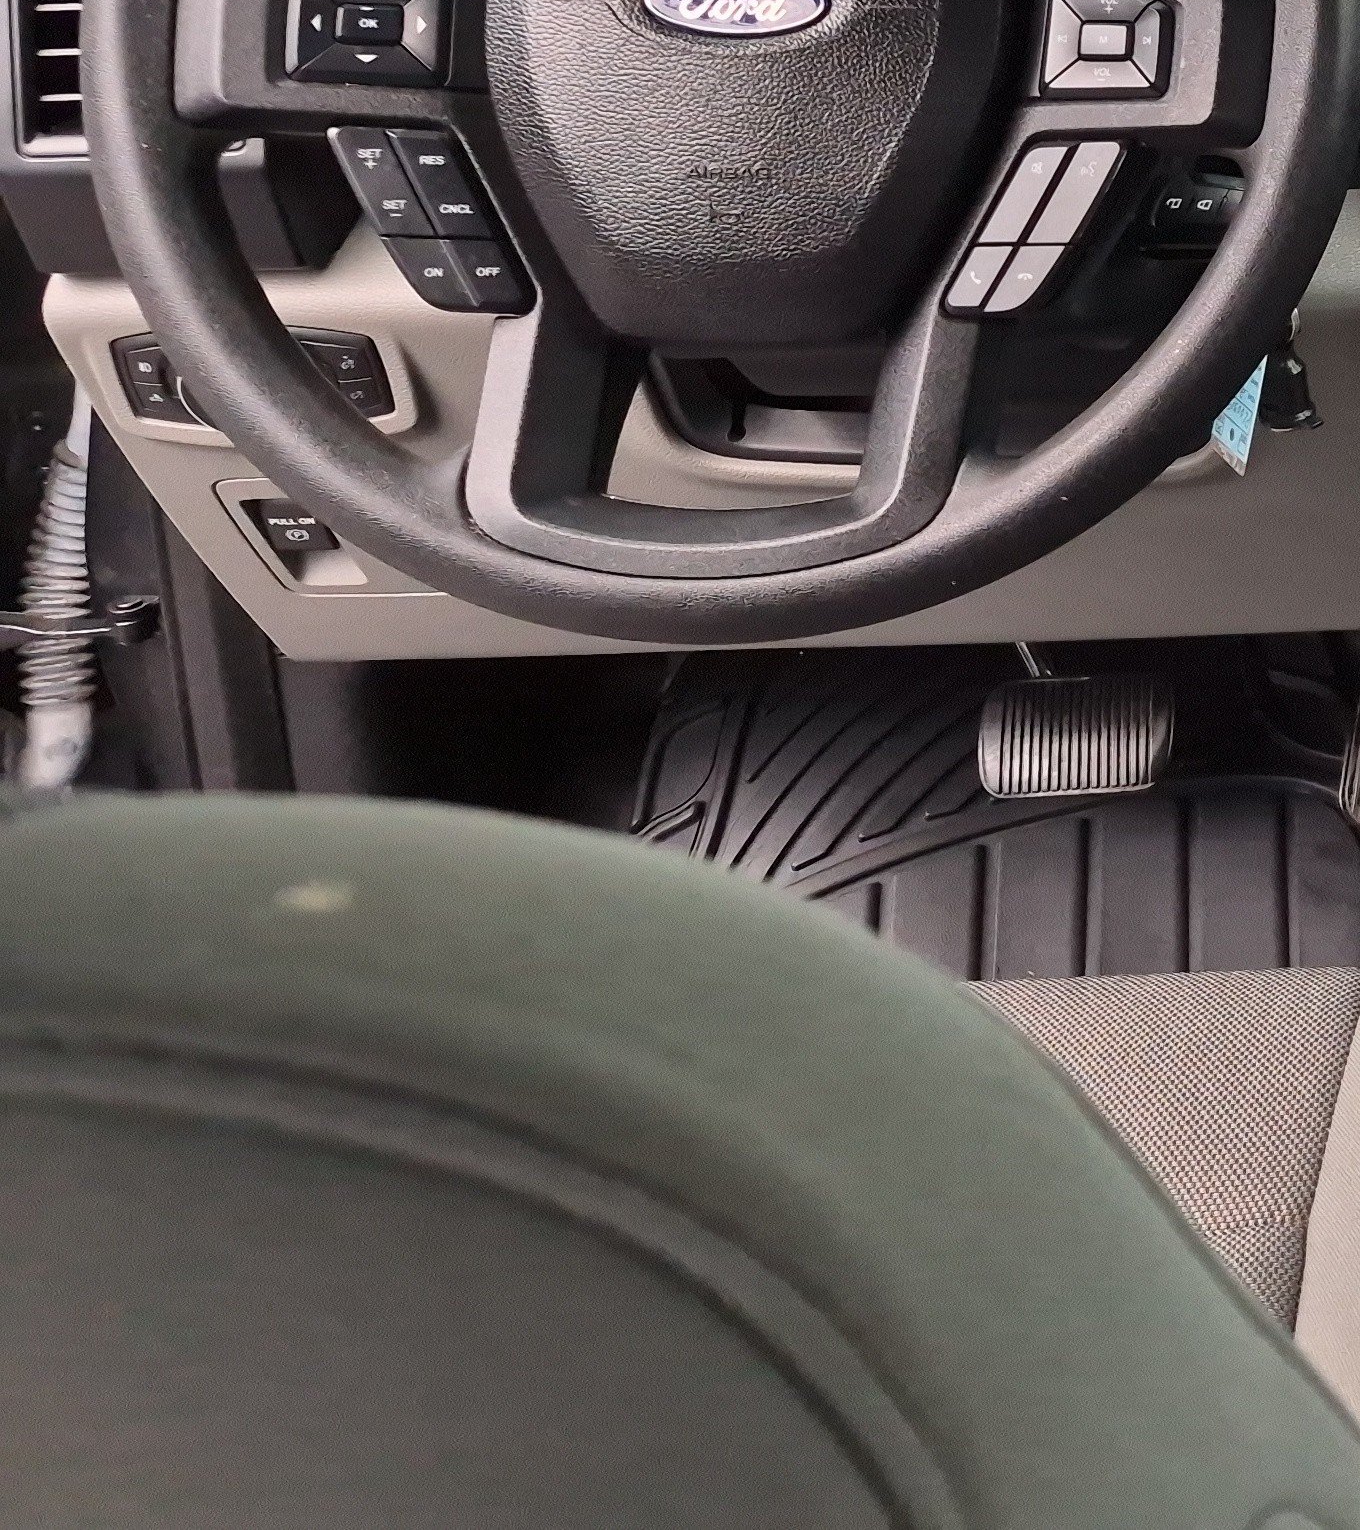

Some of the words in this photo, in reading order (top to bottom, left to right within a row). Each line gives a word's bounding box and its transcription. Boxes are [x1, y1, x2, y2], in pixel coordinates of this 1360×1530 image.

[357, 17, 380, 29] OK
[1093, 67, 1112, 77] VOL
[356, 148, 383, 159] SET
[418, 155, 446, 165] RES
[381, 199, 408, 210] SET
[438, 203, 475, 214] CNCL
[424, 267, 444, 278] ON
[475, 266, 501, 277] OFF
[267, 517, 298, 526] PULL
[298, 517, 316, 525] ON
